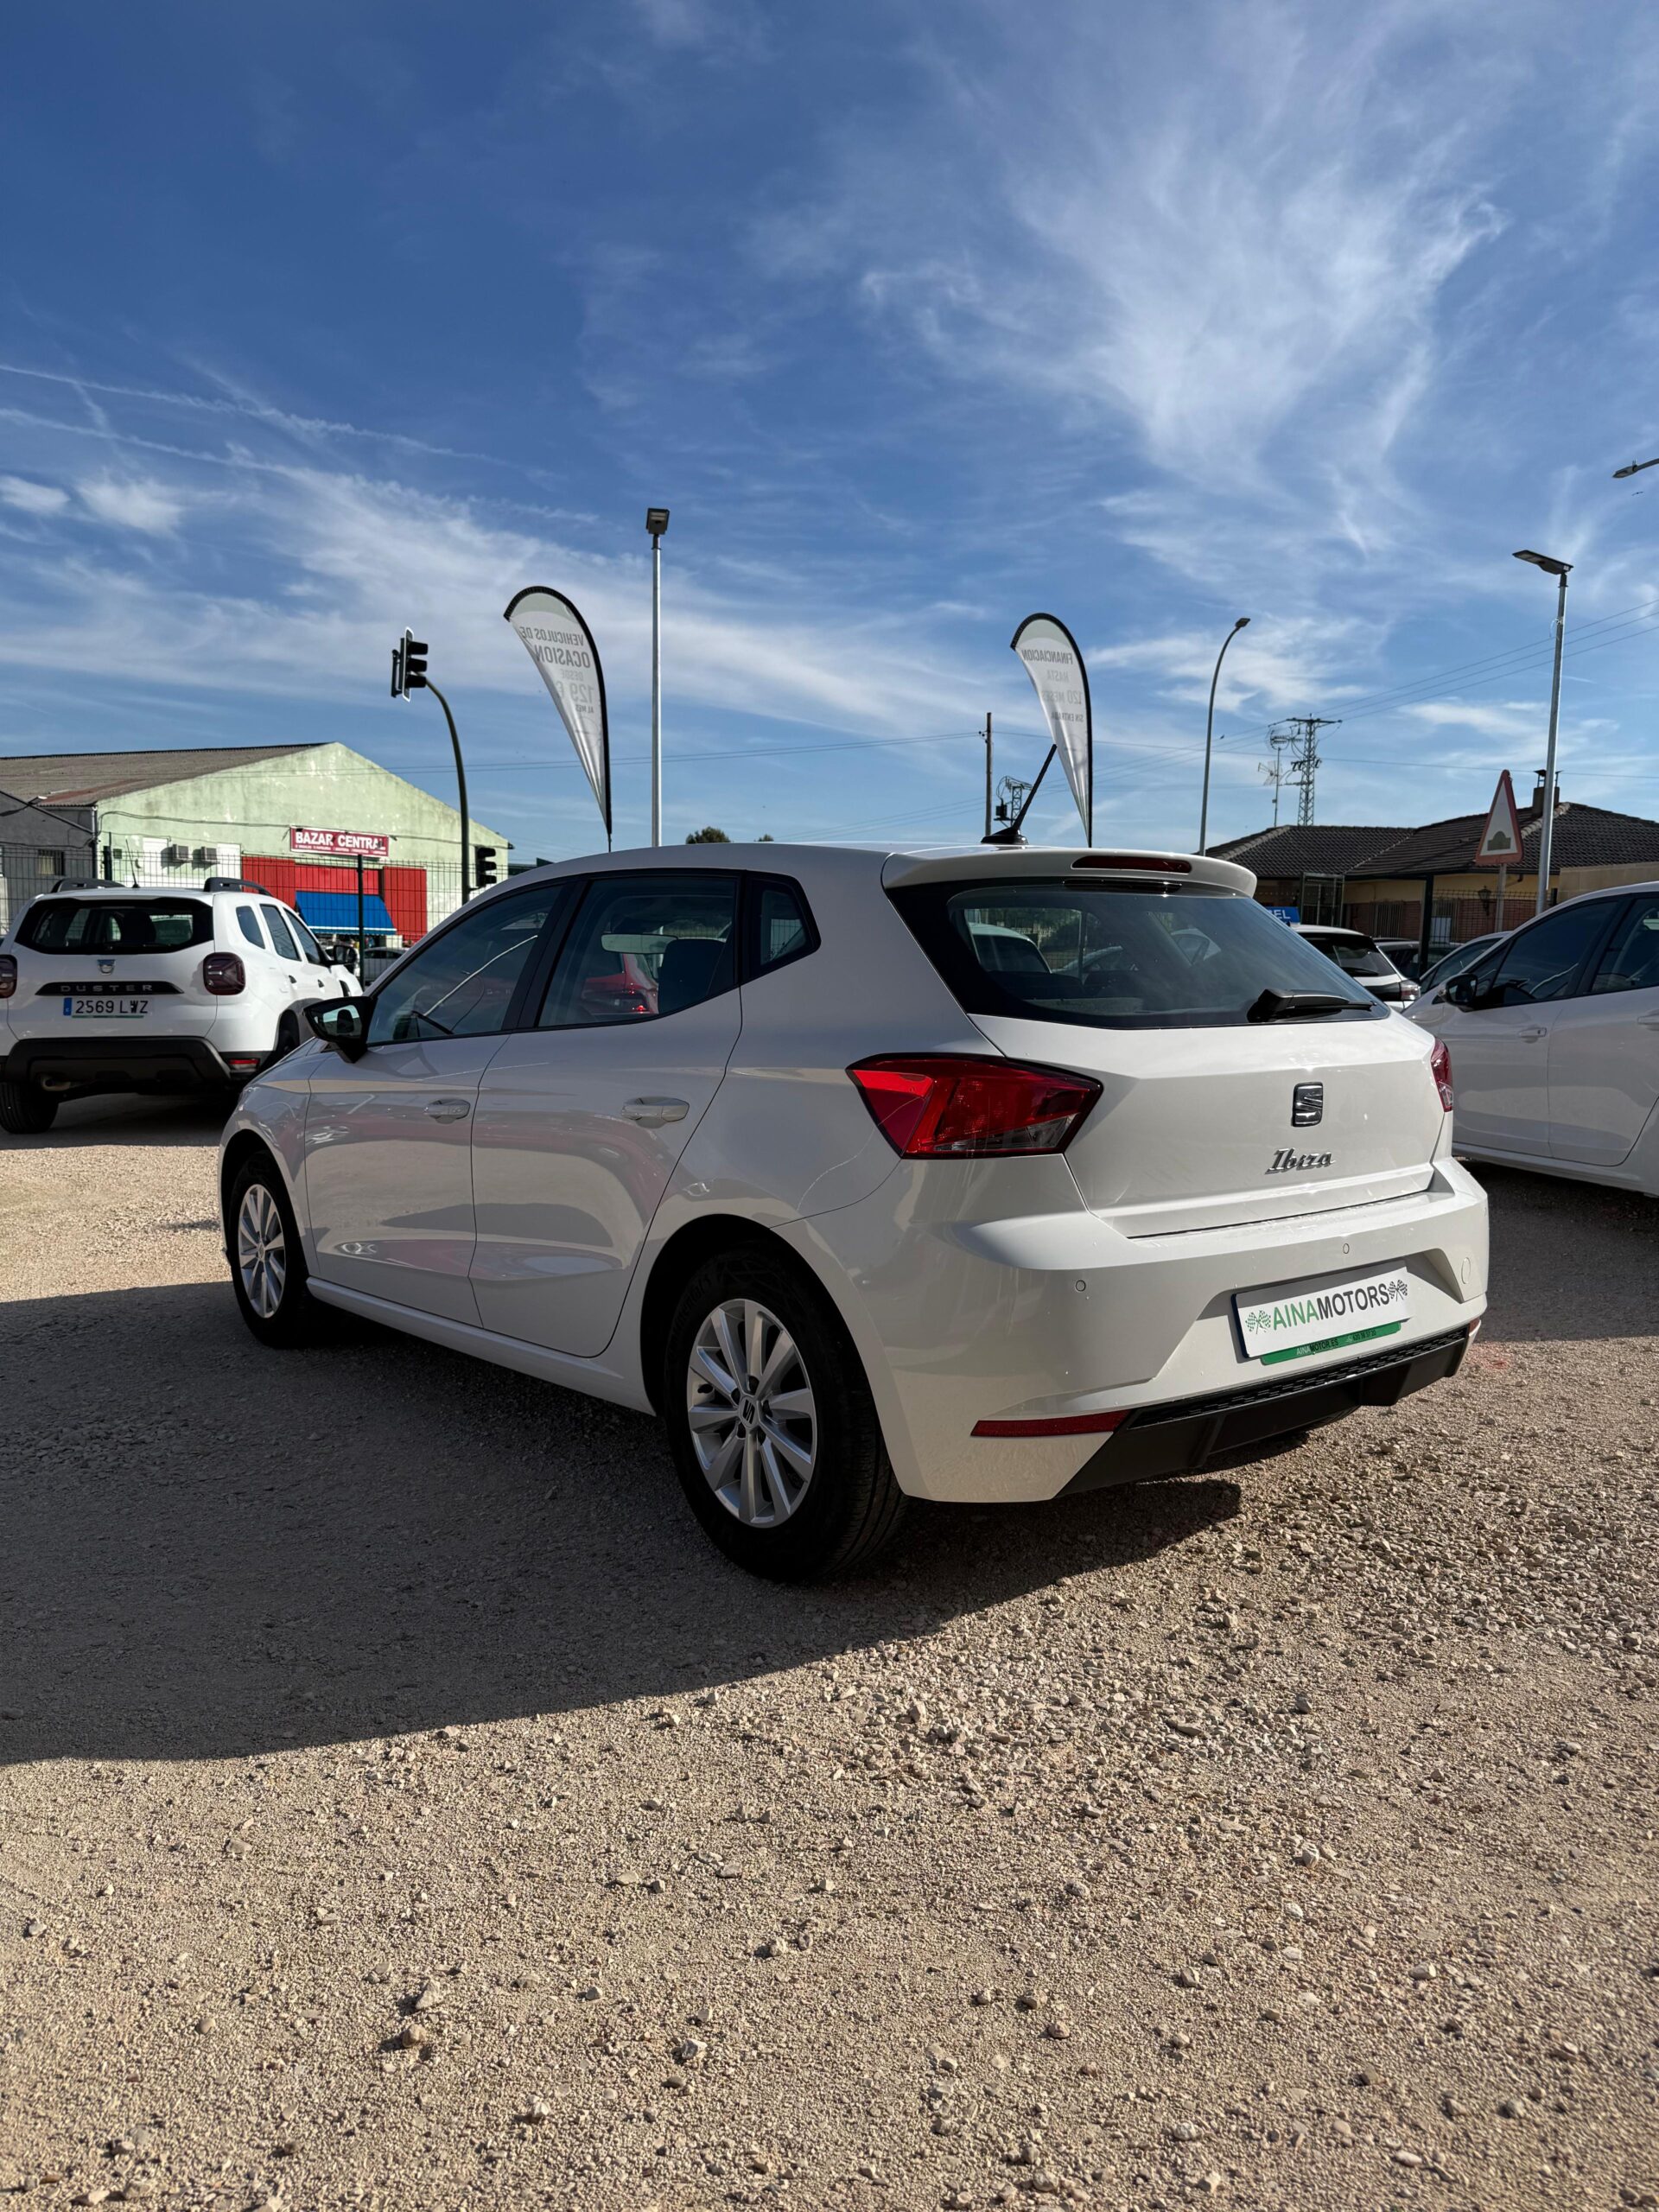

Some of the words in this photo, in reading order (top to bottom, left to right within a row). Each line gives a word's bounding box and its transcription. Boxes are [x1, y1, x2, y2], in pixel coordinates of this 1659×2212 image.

[296, 831, 334, 846] BAZAR
[338, 835, 385, 850] CENTRAL
[75, 1001, 114, 1014] 2569
[1265, 1147, 1336, 1175] Ibiza
[1273, 1283, 1390, 1331] AINAMOTORS
